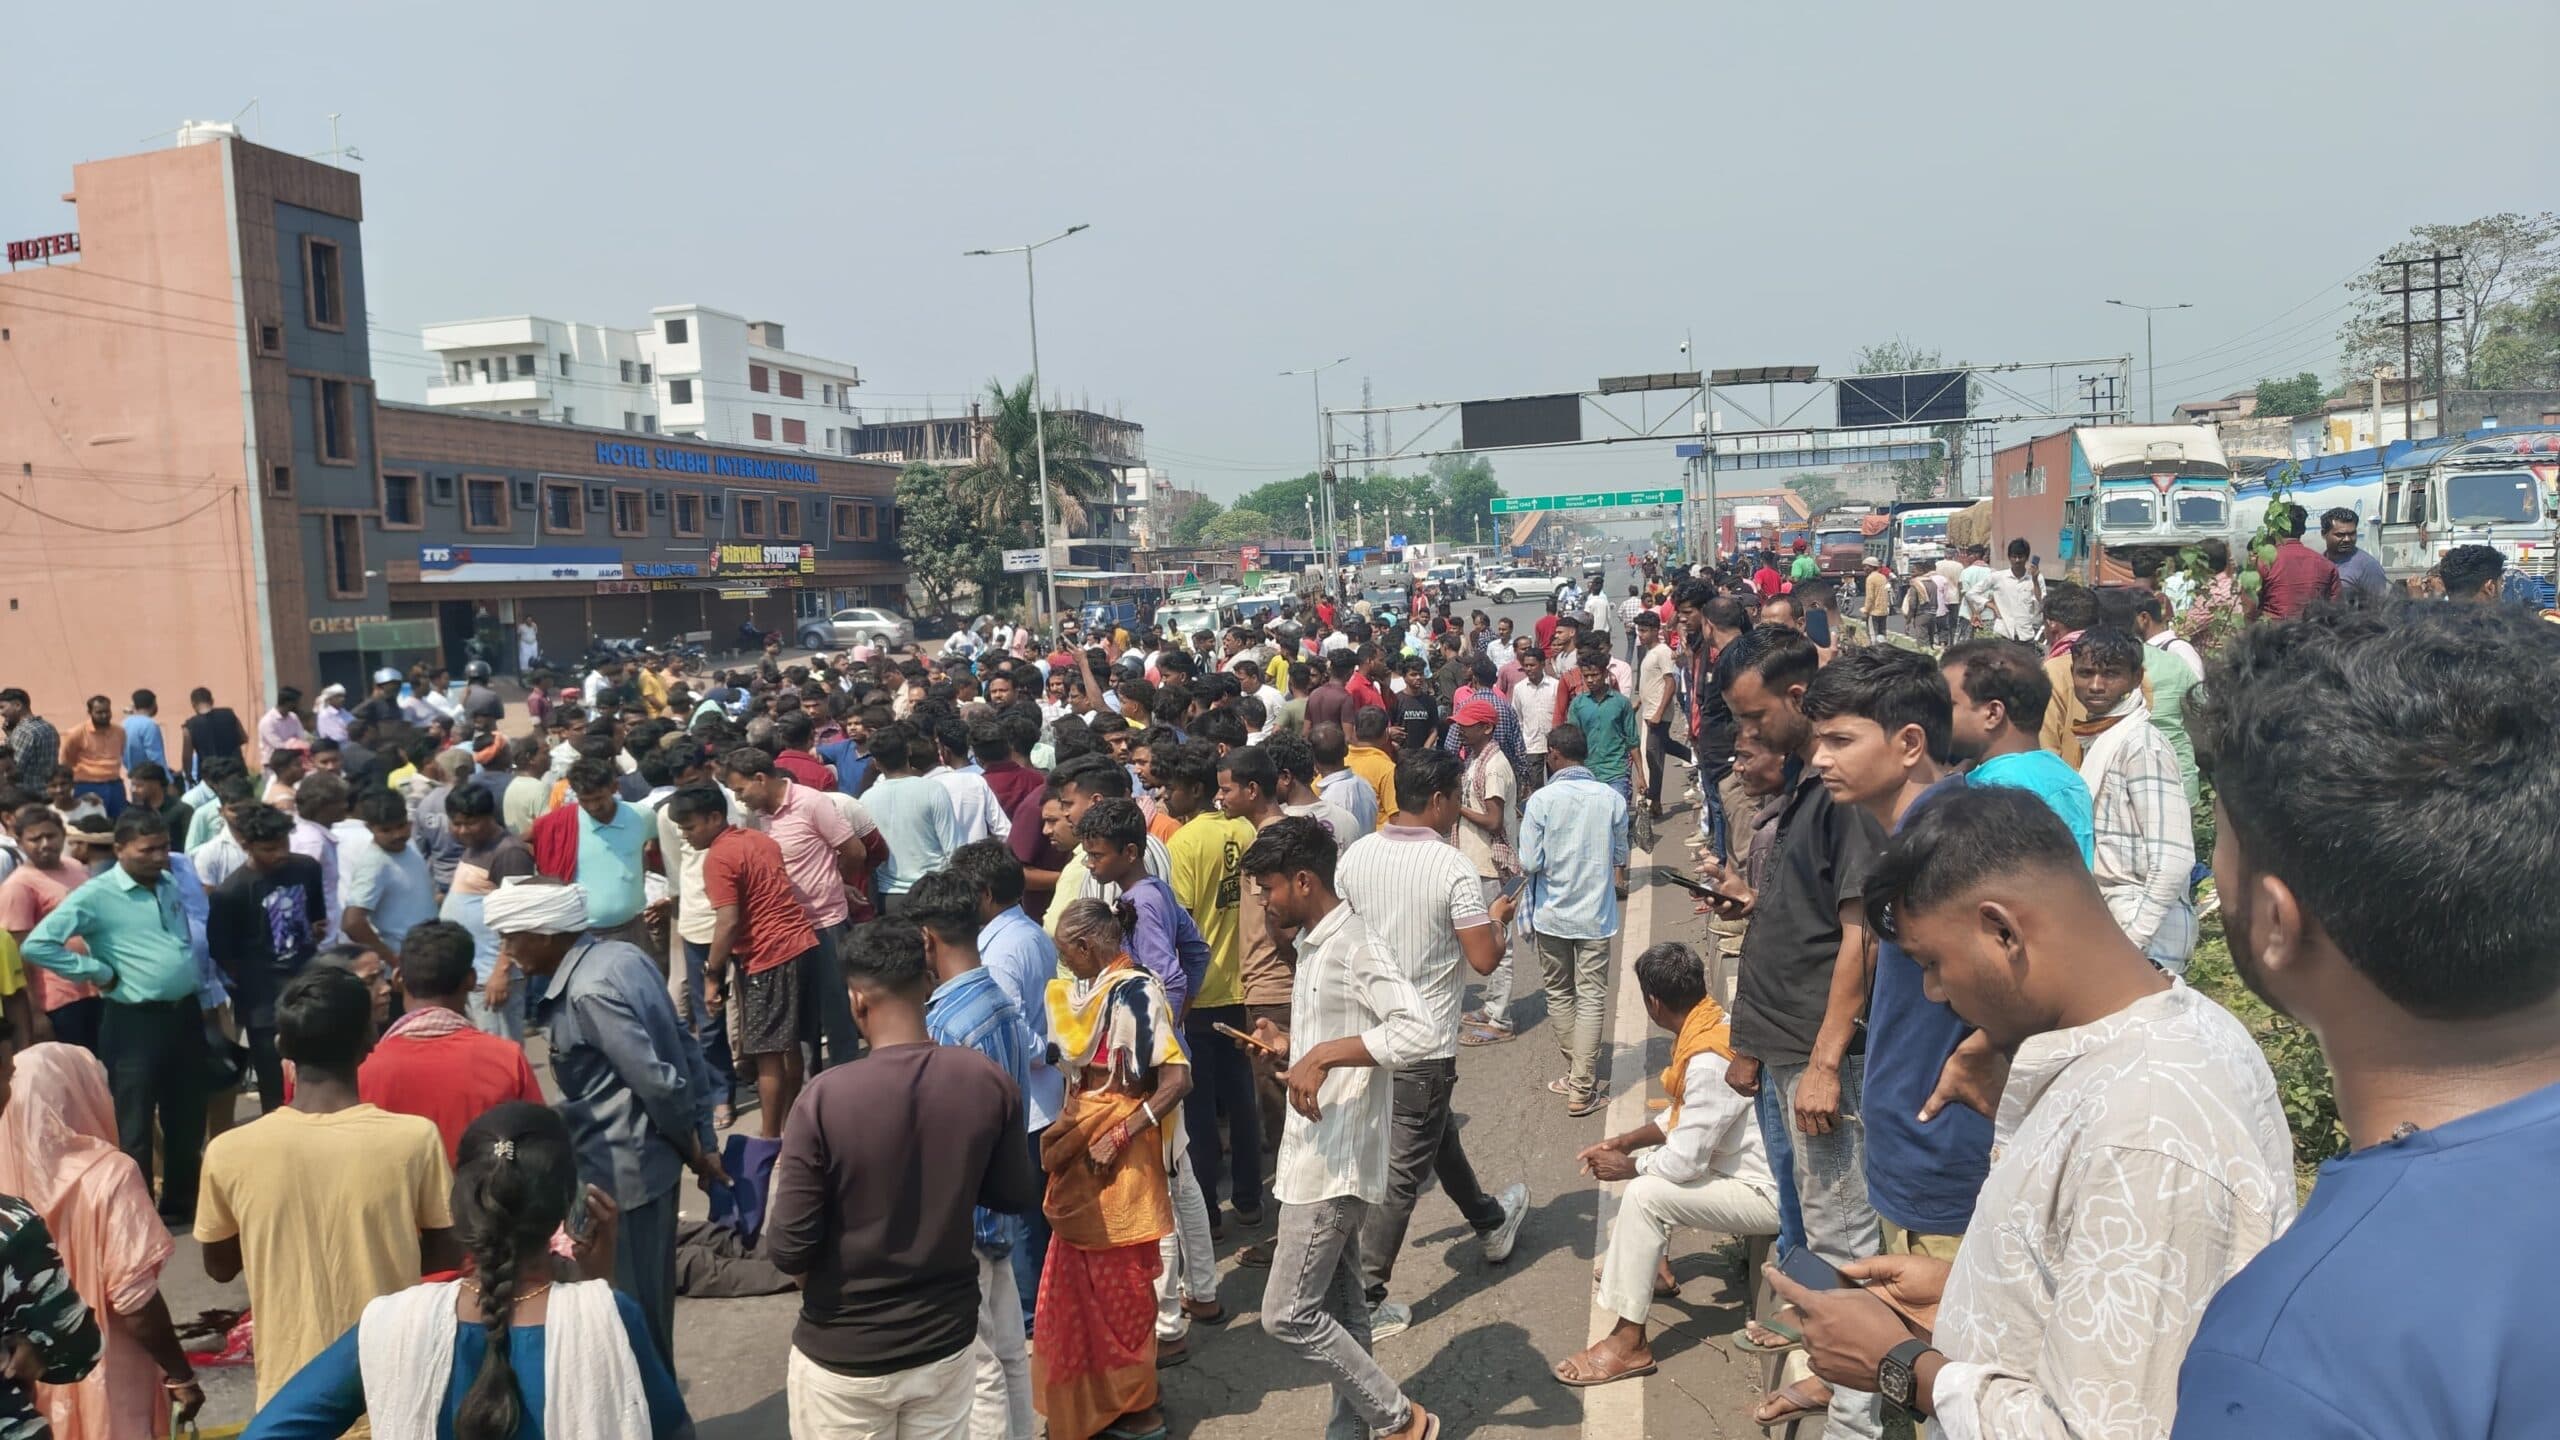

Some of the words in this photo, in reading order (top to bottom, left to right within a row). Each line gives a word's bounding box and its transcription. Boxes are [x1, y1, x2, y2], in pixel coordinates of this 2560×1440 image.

[7, 232, 80, 262] HOTEL
[596, 442, 649, 469] HOTEL
[655, 447, 710, 474] SURBHI
[714, 456, 819, 483] INTERNATIONAL
[423, 549, 450, 562] TVS
[763, 546, 800, 563] STREET
